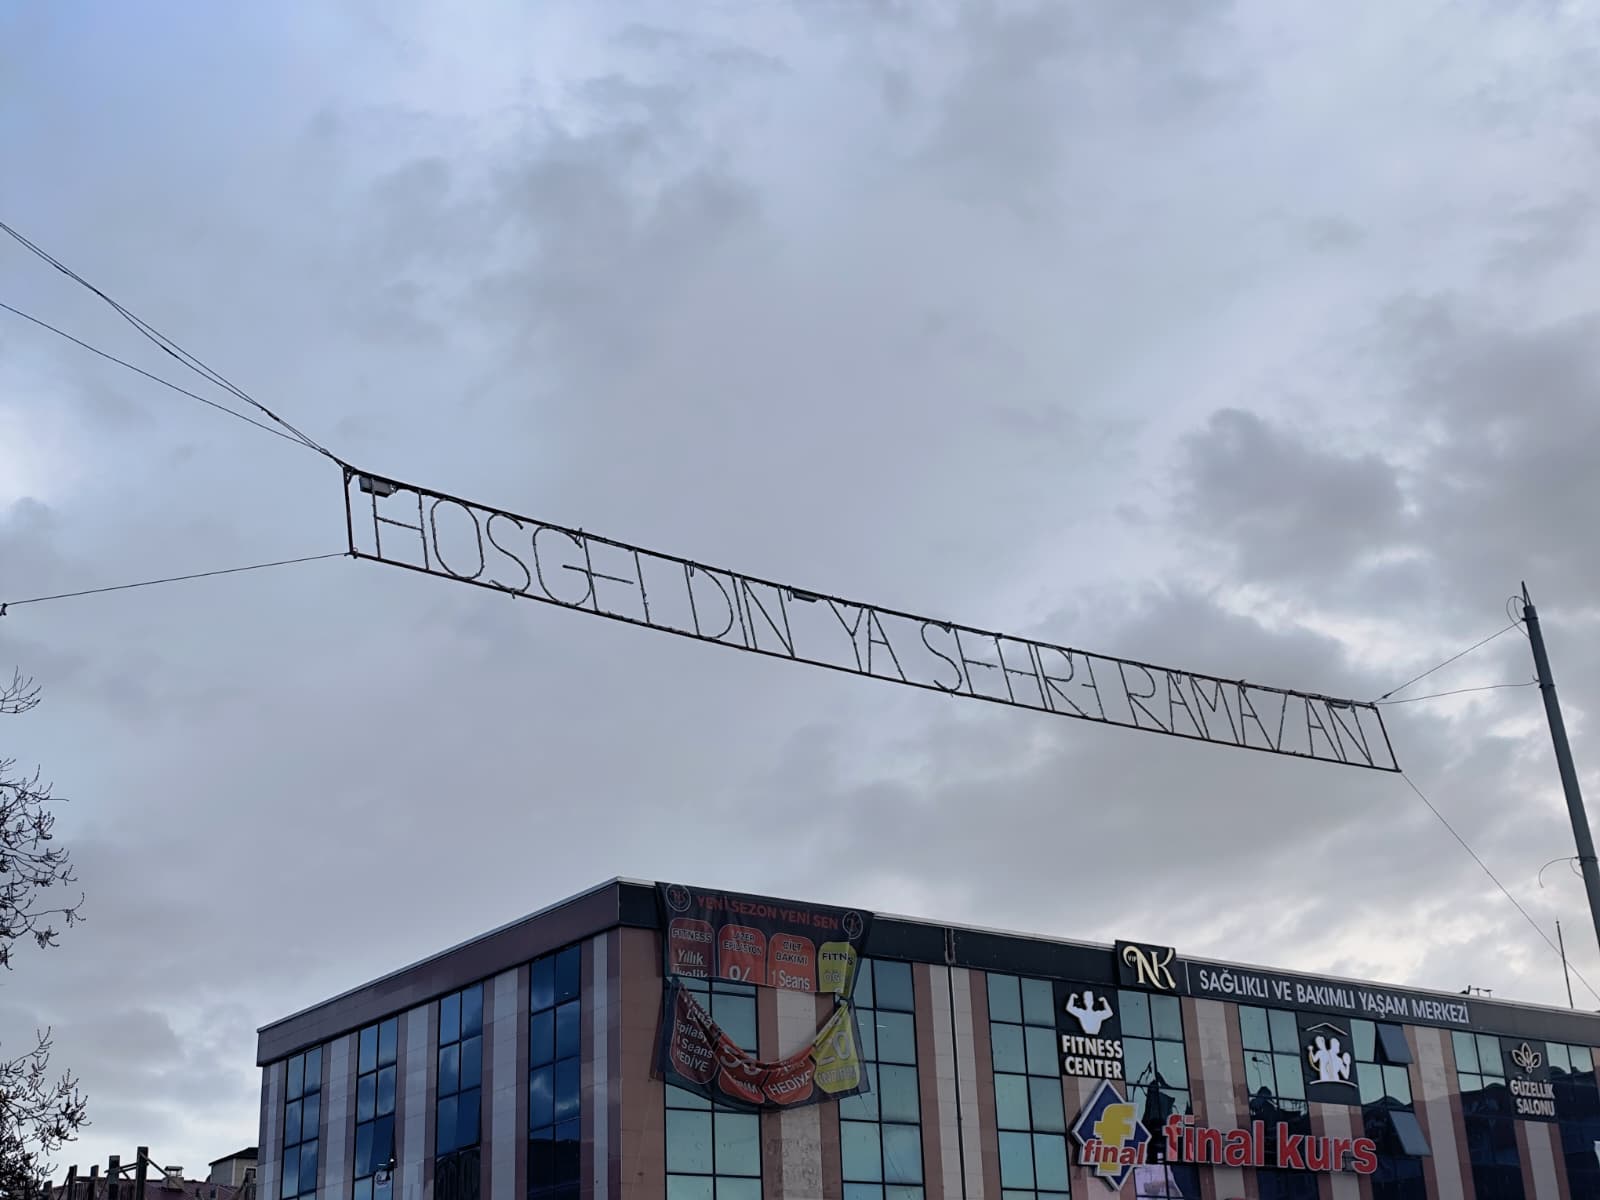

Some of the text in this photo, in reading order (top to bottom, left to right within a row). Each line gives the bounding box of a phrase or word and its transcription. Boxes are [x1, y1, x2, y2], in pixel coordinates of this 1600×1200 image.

[827, 598, 906, 683] YA
[731, 901, 777, 920] SEZON
[813, 914, 839, 930] SEN
[779, 970, 811, 990] Seans
[1199, 968, 1470, 1024] SAĞLIKLI VE BAKIMLI YAŞAM MERKEZİ
[681, 1038, 715, 1059] Seans
[1061, 1034, 1123, 1059] FITNESS
[1064, 1056, 1123, 1080] CENTER
[1516, 1097, 1556, 1117] SALONU
[1083, 1138, 1147, 1165] final
[1162, 1113, 1378, 1174] final kurs
